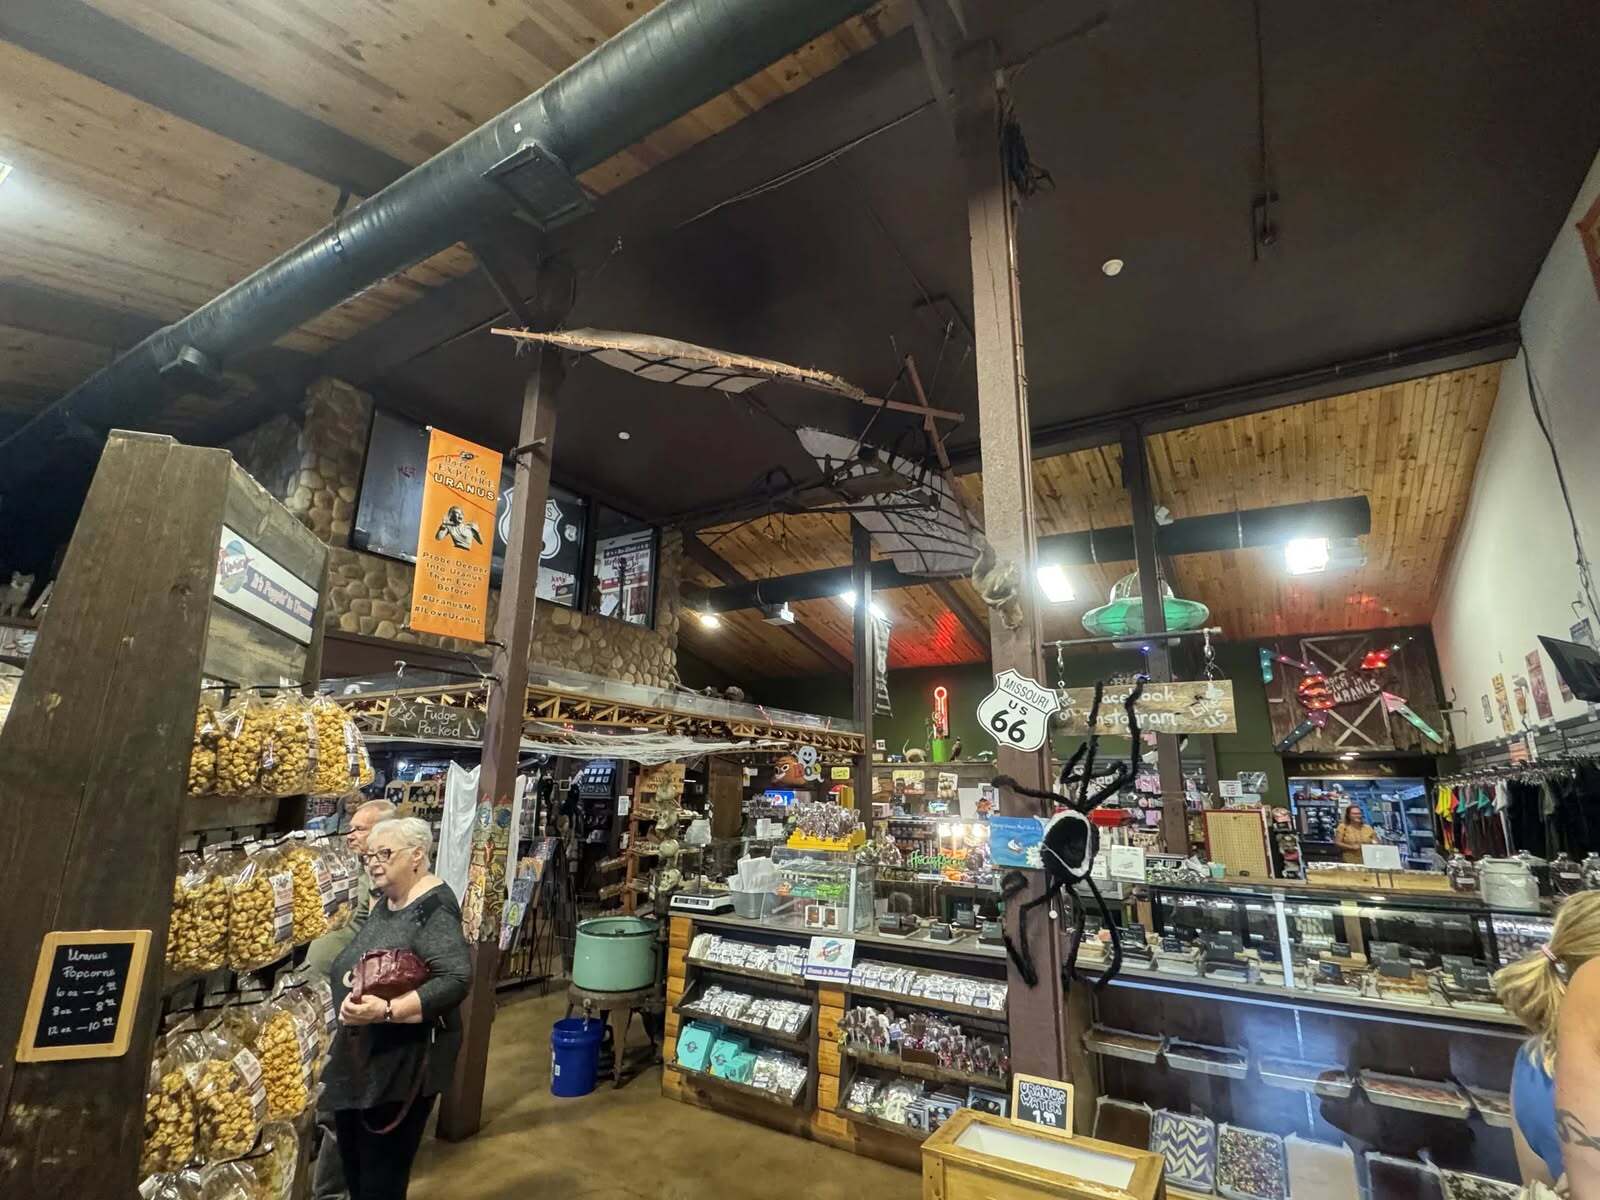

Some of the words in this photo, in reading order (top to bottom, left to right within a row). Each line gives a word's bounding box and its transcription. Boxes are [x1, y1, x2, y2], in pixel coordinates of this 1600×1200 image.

[433, 472, 496, 501] URANUS
[423, 551, 450, 565] Probe
[449, 567, 482, 581] Uranus
[437, 583, 470, 597] Before
[1004, 678, 1049, 709] MISSOURI
[1100, 686, 1176, 704] aceook
[423, 704, 457, 724] Fudge
[1204, 709, 1228, 728] us
[417, 720, 461, 737] Packed
[990, 710, 1027, 743] 66
[68, 948, 109, 961] Uranus
[1020, 1082, 1066, 1105] URANUS
